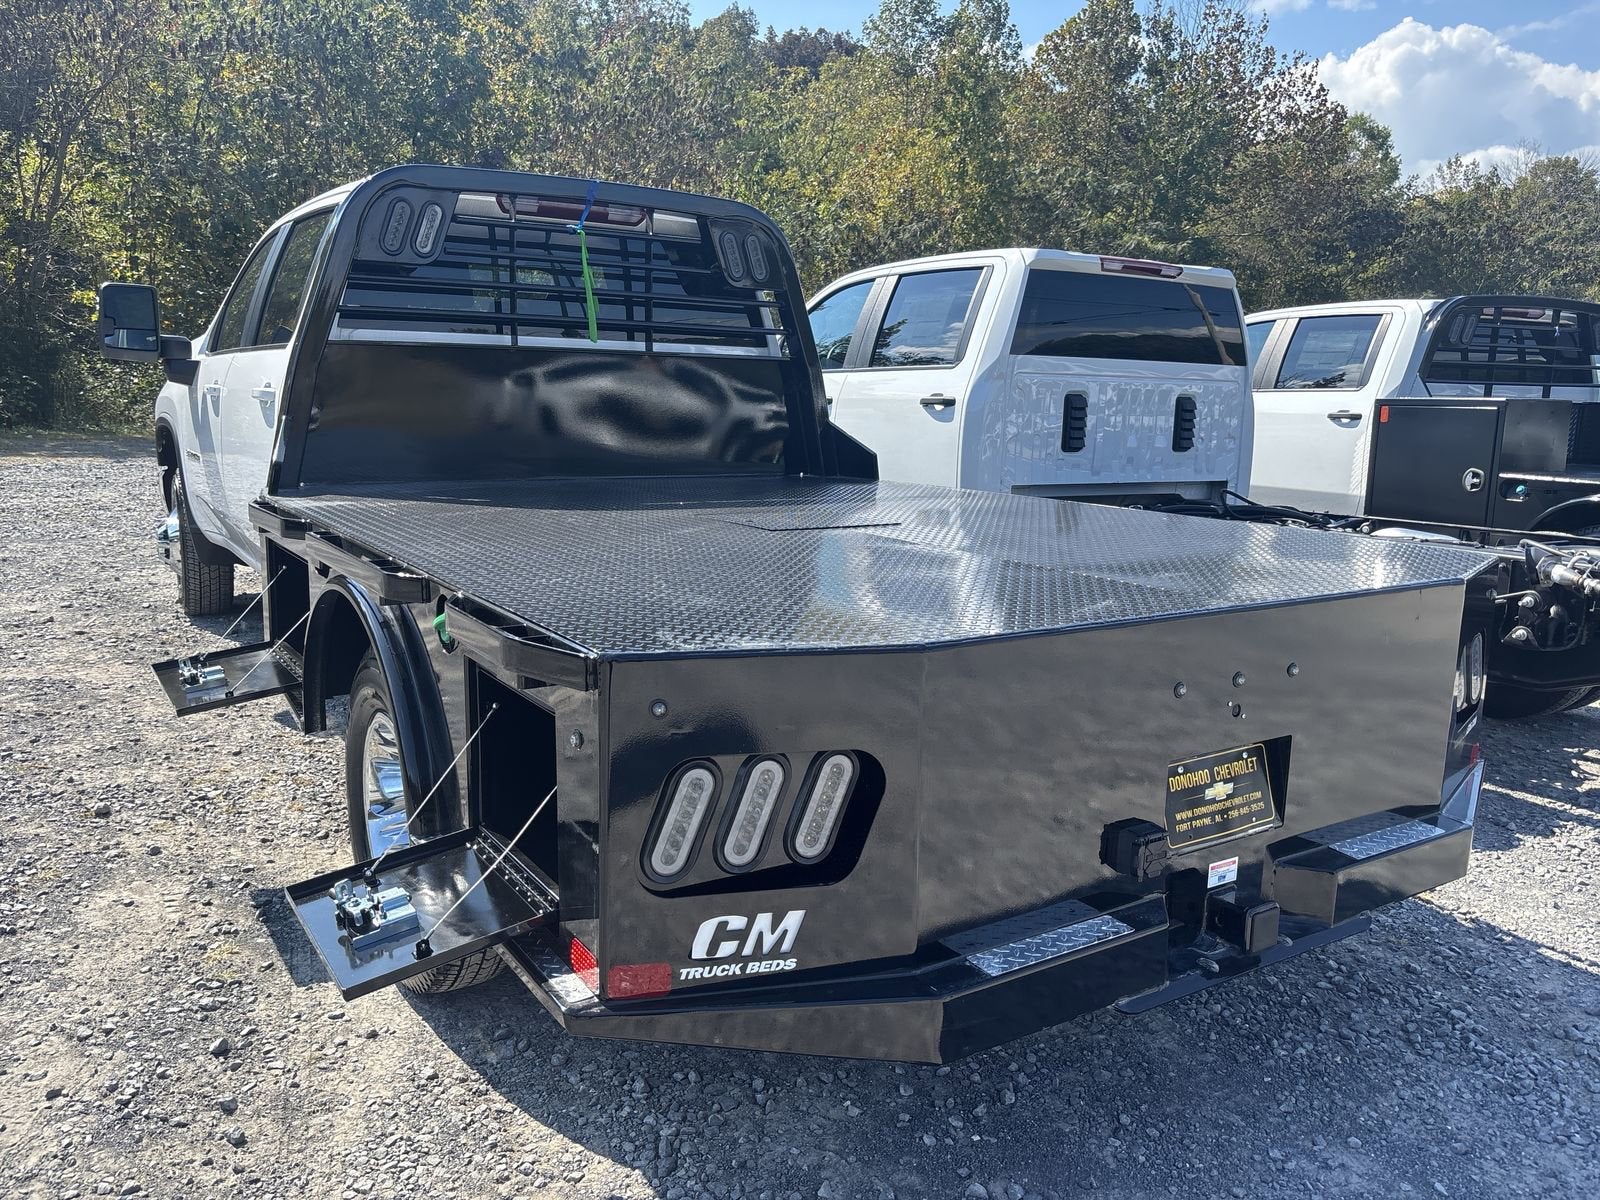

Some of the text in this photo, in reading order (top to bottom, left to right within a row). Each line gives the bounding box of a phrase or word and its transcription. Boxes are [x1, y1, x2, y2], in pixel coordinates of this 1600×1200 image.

[1168, 757, 1258, 792] DONOHOO CHEVROLET
[1175, 791, 1262, 821] WWW.DONOHOOCHEVROLET.COM
[1175, 823, 1191, 833] FORT
[1215, 814, 1223, 822] AL
[690, 909, 808, 960] CM
[679, 958, 798, 981] TRUCK BEDS
